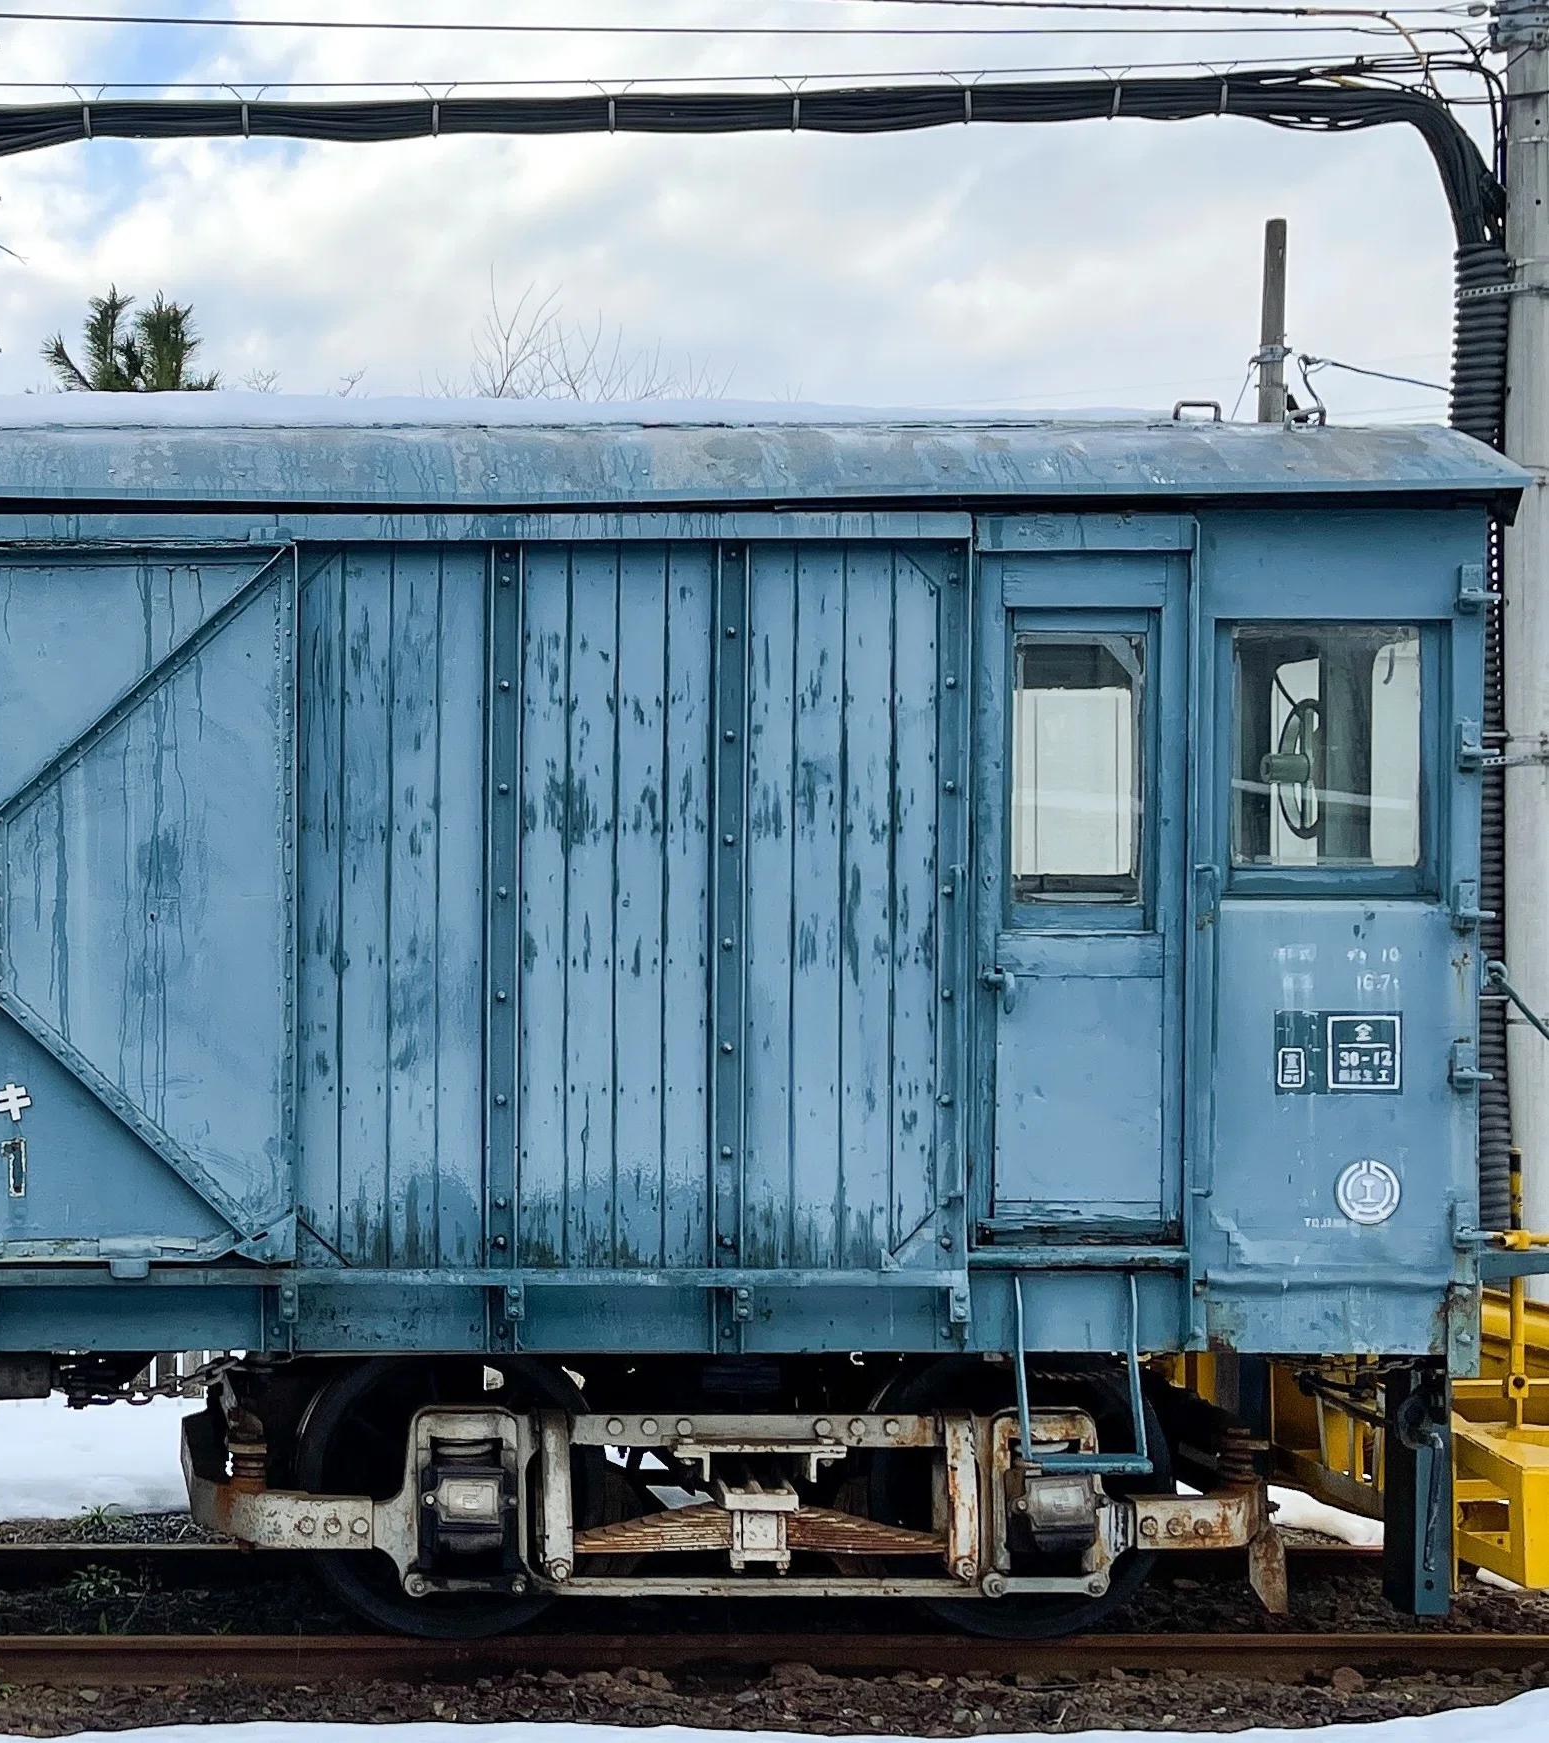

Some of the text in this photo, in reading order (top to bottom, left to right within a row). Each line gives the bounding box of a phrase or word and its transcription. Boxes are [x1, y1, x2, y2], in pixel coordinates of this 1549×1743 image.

[1381, 947, 1400, 962] 10
[1355, 1022, 1373, 1041] 全
[1339, 1050, 1393, 1067] 30-12
